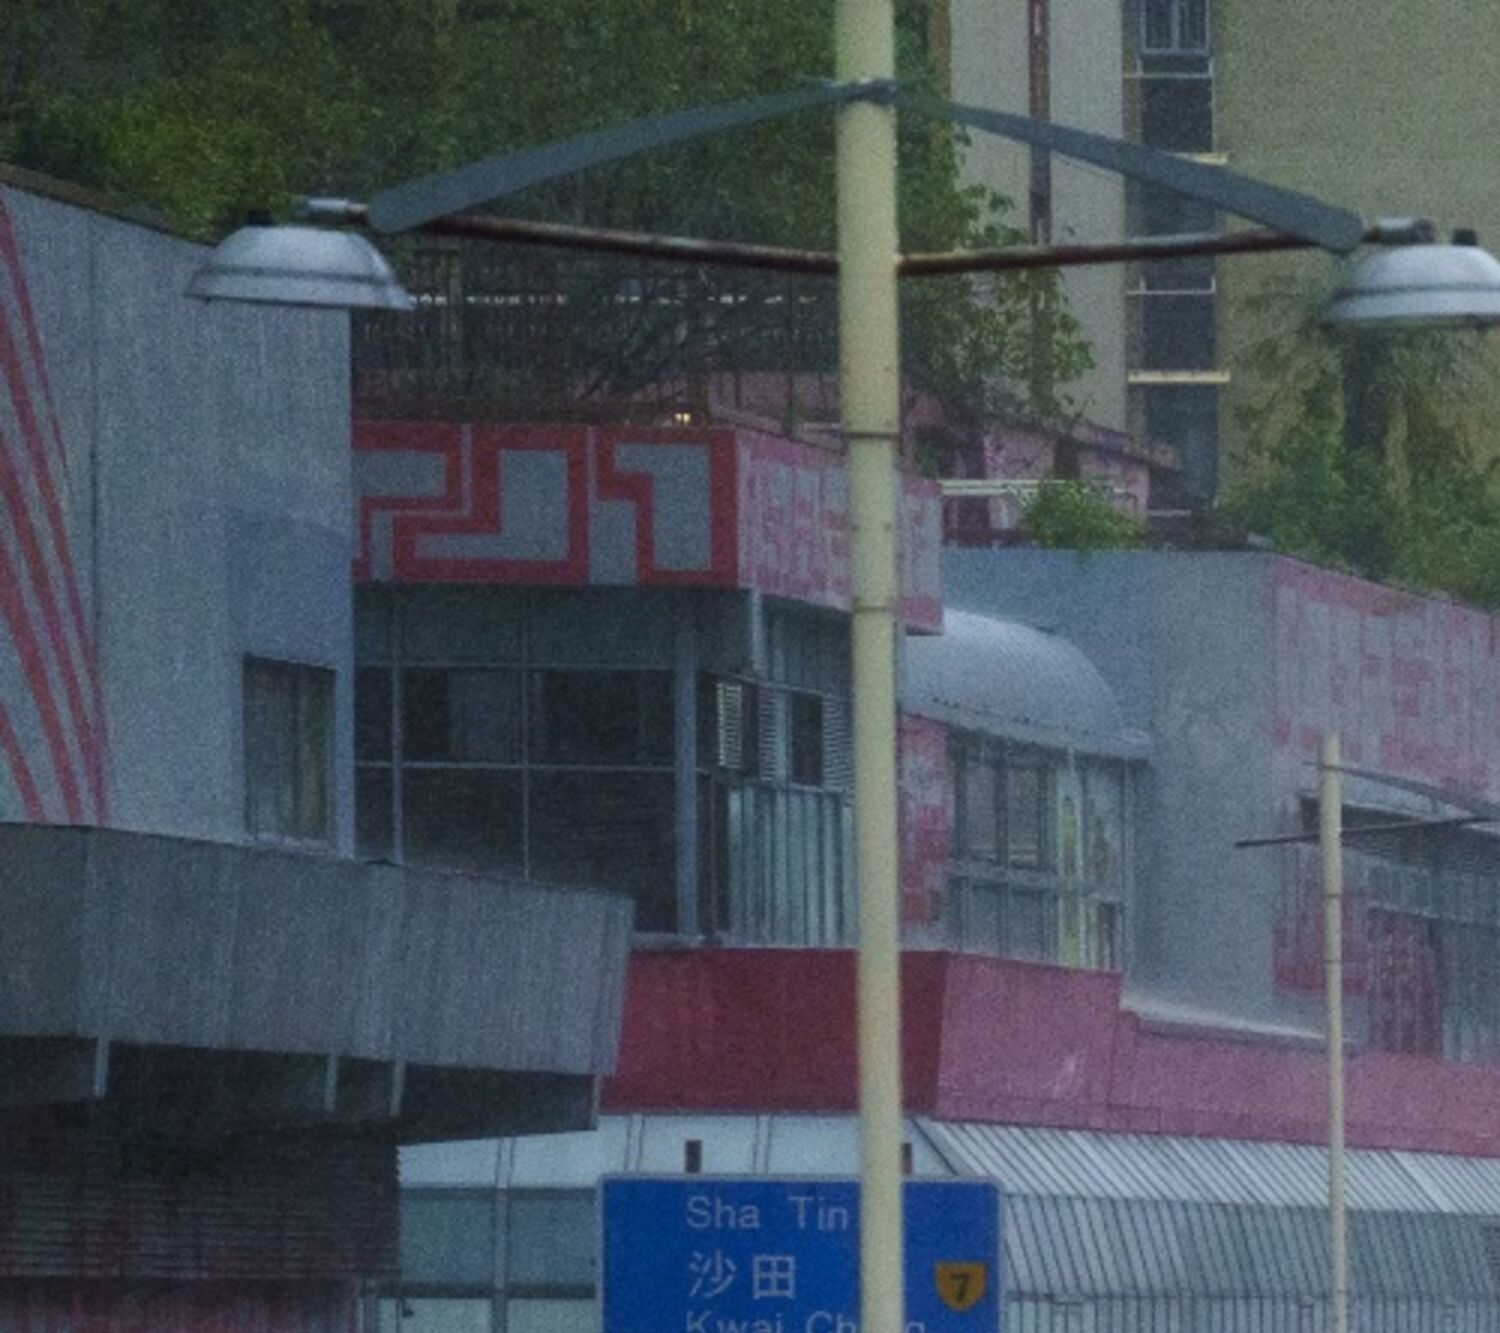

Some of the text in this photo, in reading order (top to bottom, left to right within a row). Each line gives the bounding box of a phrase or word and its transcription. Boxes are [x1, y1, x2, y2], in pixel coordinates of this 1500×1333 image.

[686, 1195, 850, 1231] Sha Tin
[689, 1249, 796, 1301] 沙田
[949, 1272, 971, 1304] 7
